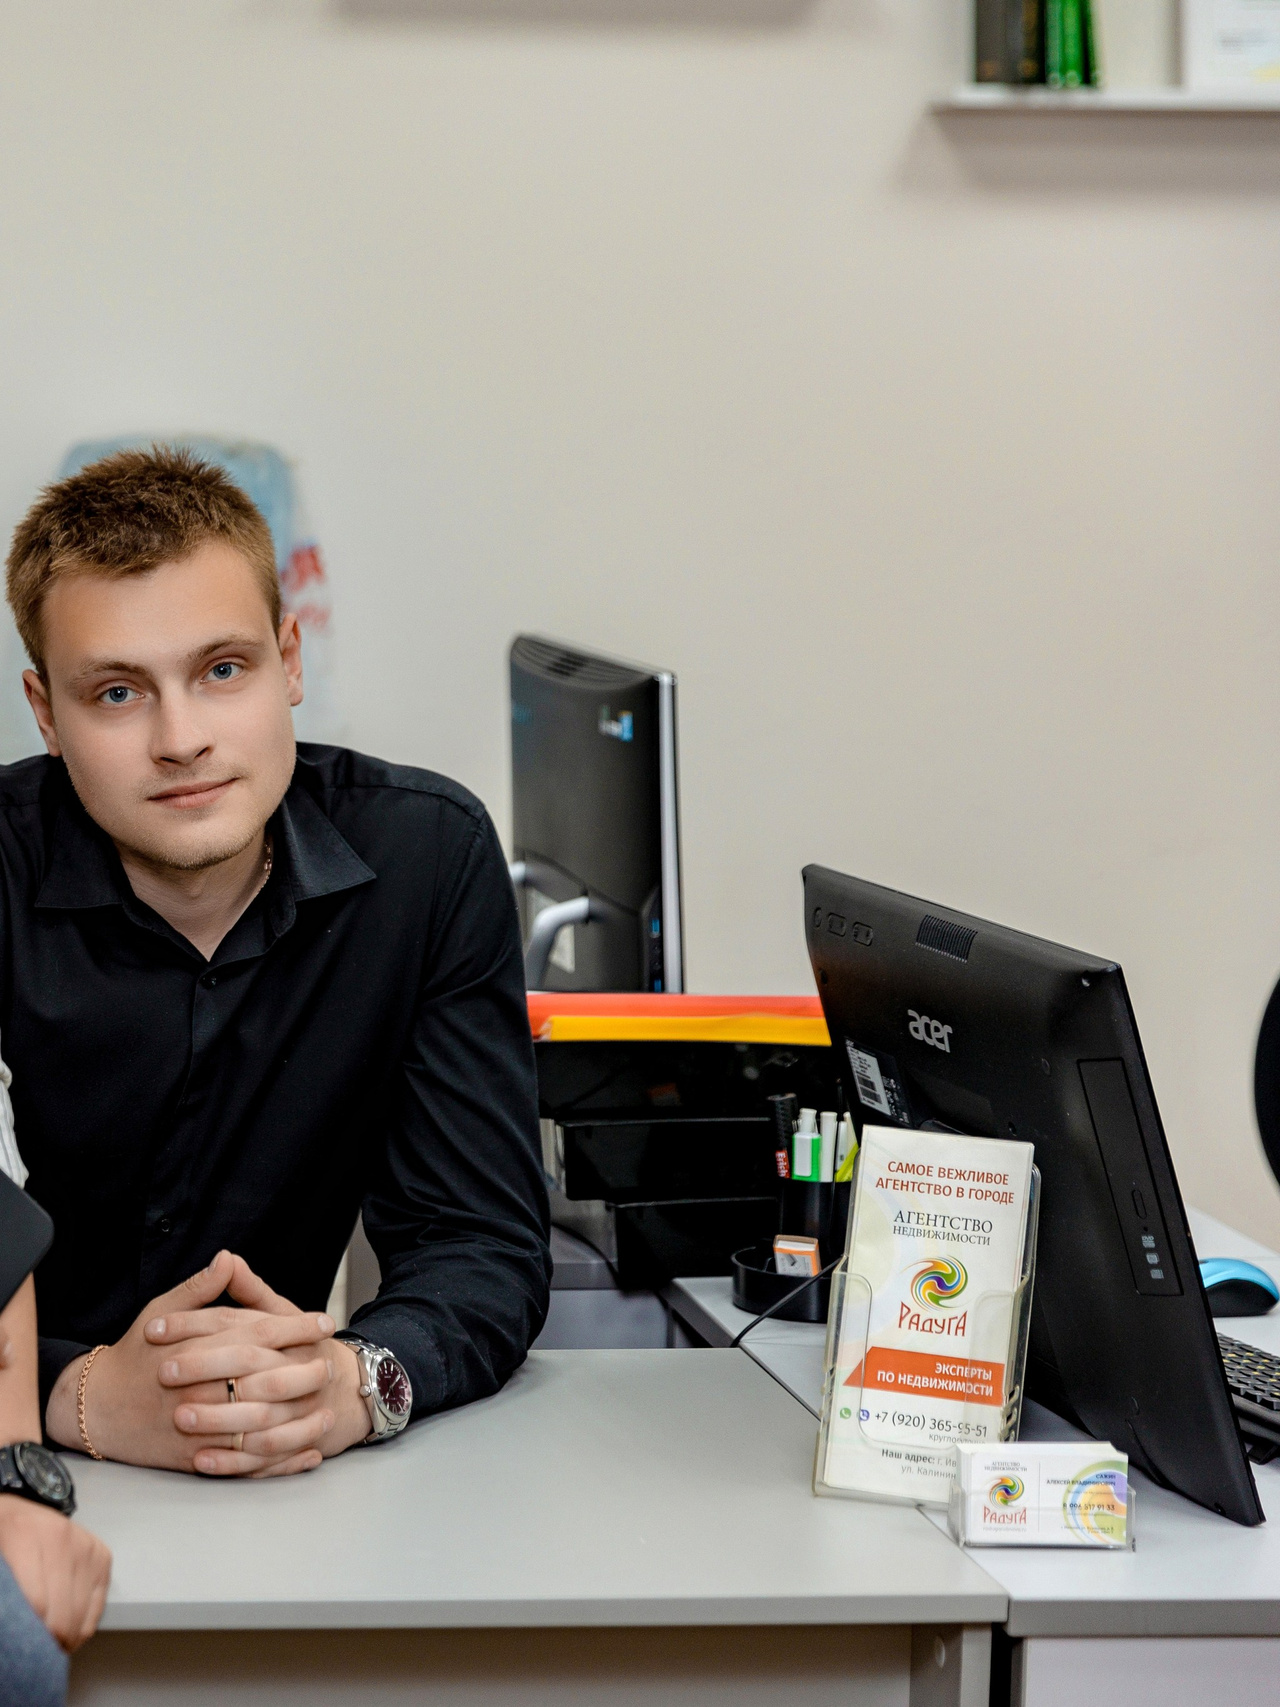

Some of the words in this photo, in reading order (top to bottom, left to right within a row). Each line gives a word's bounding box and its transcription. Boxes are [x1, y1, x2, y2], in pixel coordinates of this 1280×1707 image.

[907, 1009, 953, 1053] acer
[887, 1161, 934, 1177] САМОЕ
[938, 1167, 1009, 1185] ВЕЖЛИВОЕ
[875, 1177, 952, 1197] АГЕНТСТВО
[956, 1187, 964, 1198] В
[969, 1188, 1014, 1205] ГОРОДЕ
[894, 1210, 993, 1233] АГЕНТСТВО
[893, 1225, 991, 1245] НЕДВИЖИМОСТИ
[935, 1362, 992, 1381] ЭКСПЕРТЫ
[877, 1370, 895, 1383] ПО
[898, 1373, 993, 1397] НЕДВИЖИМОСТИ
[875, 1411, 888, 1423] +7
[892, 1411, 926, 1430] (920)
[929, 1418, 987, 1438] 365-95-51
[881, 1449, 902, 1459] Наш
[905, 1453, 935, 1464] адрес:
[901, 1465, 914, 1474] ул.
